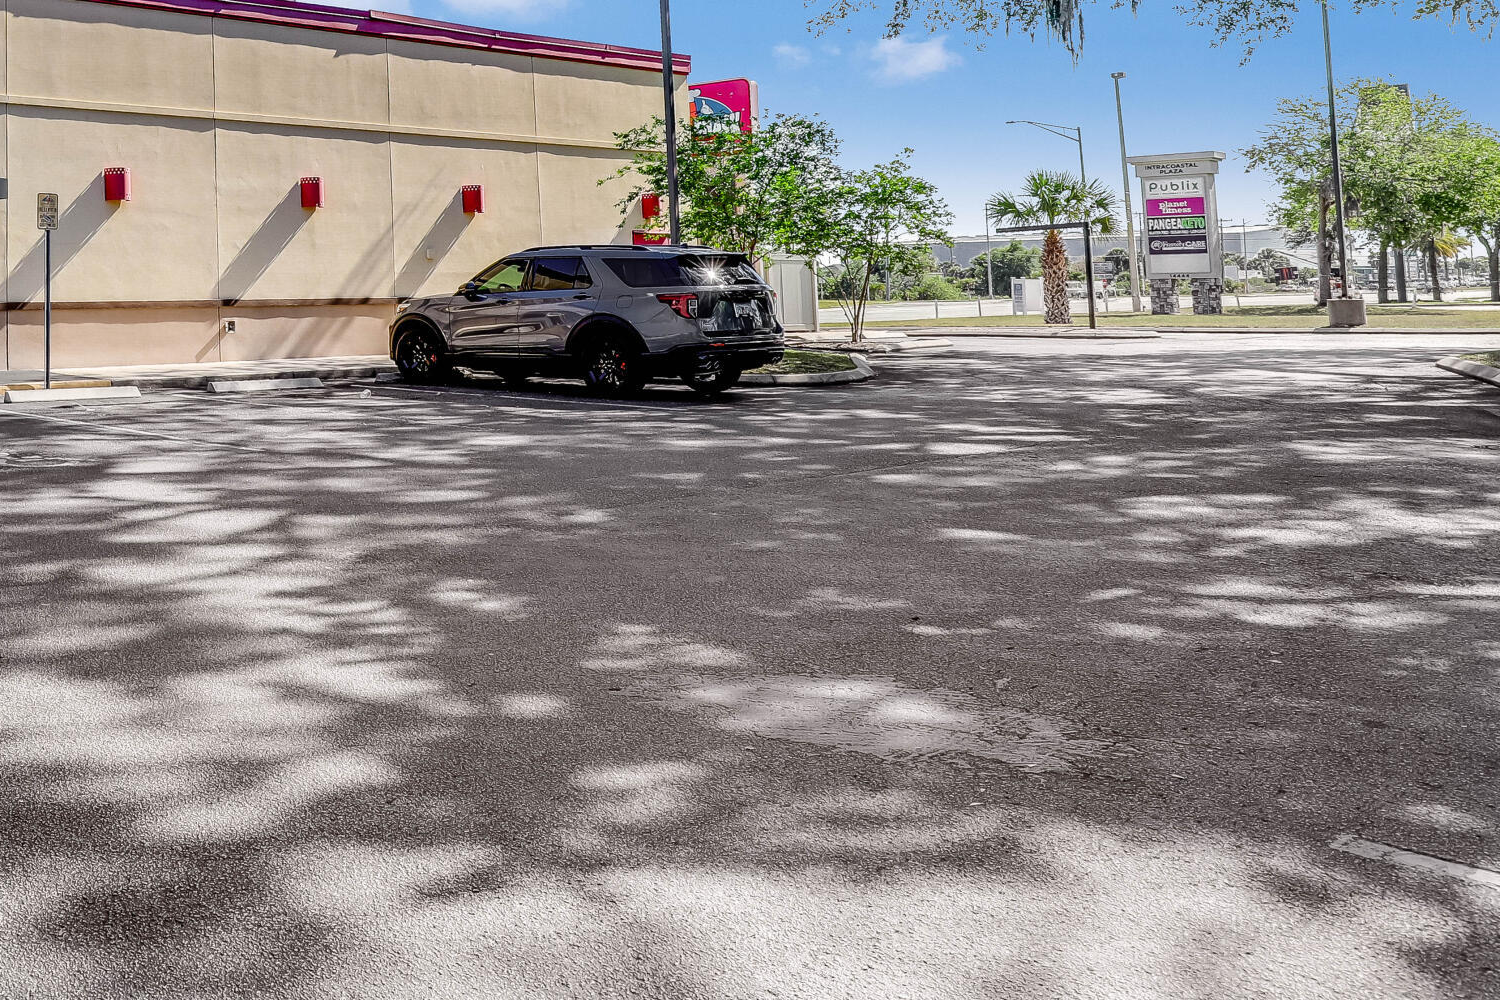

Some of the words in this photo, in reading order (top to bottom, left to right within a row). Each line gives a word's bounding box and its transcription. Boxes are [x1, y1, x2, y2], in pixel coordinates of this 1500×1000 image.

[1144, 162, 1198, 170] INTRACOASTAL
[1149, 180, 1199, 192] Publix
[1158, 201, 1188, 209] planet
